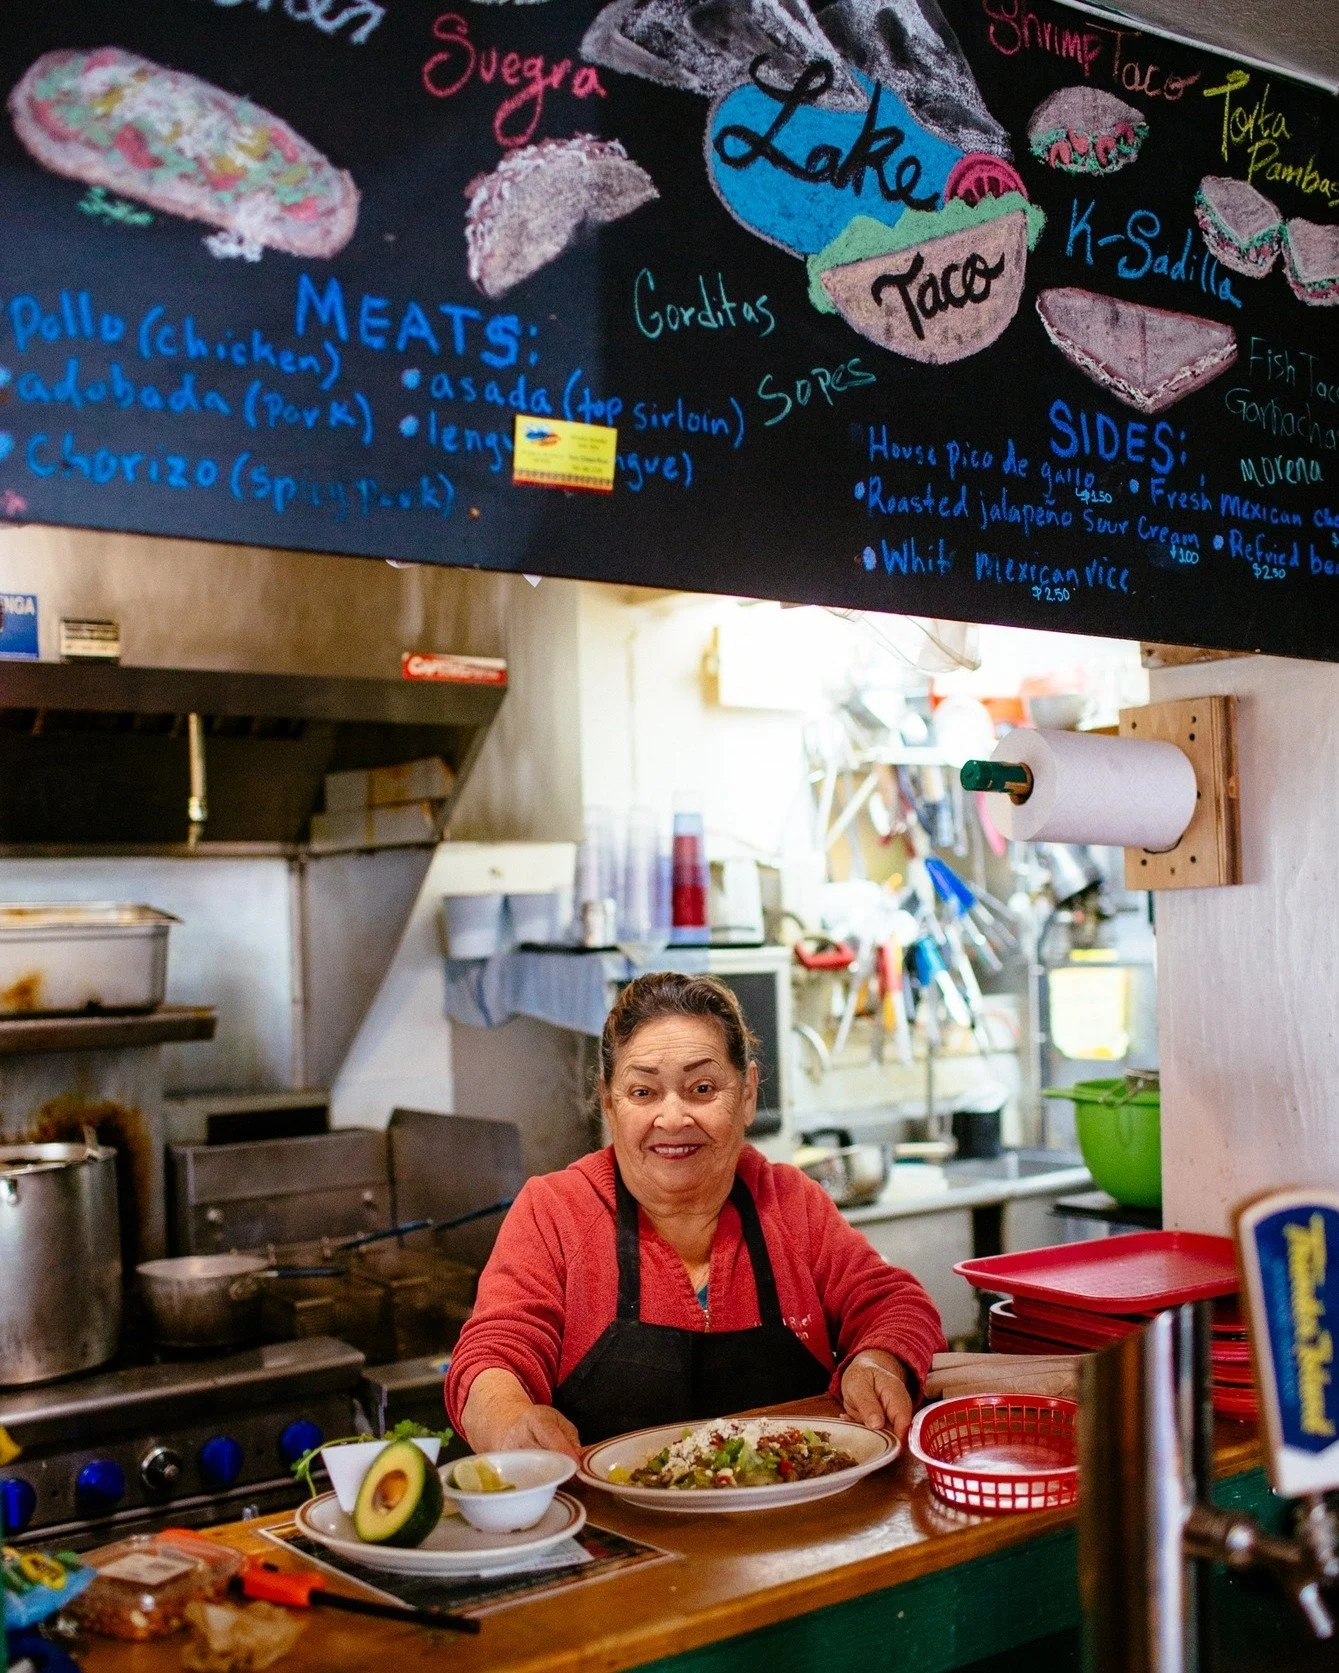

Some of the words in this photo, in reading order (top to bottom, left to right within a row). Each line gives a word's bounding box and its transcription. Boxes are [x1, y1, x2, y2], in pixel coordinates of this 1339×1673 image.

[1085, 22, 1201, 101] Taco
[713, 52, 943, 213] Lake
[295, 271, 539, 370] MEATS:
[871, 252, 1006, 342] Taco
[1003, 438, 1029, 478] de
[1048, 398, 1188, 477] SIDES:
[1225, 387, 1339, 451] Garnacha
